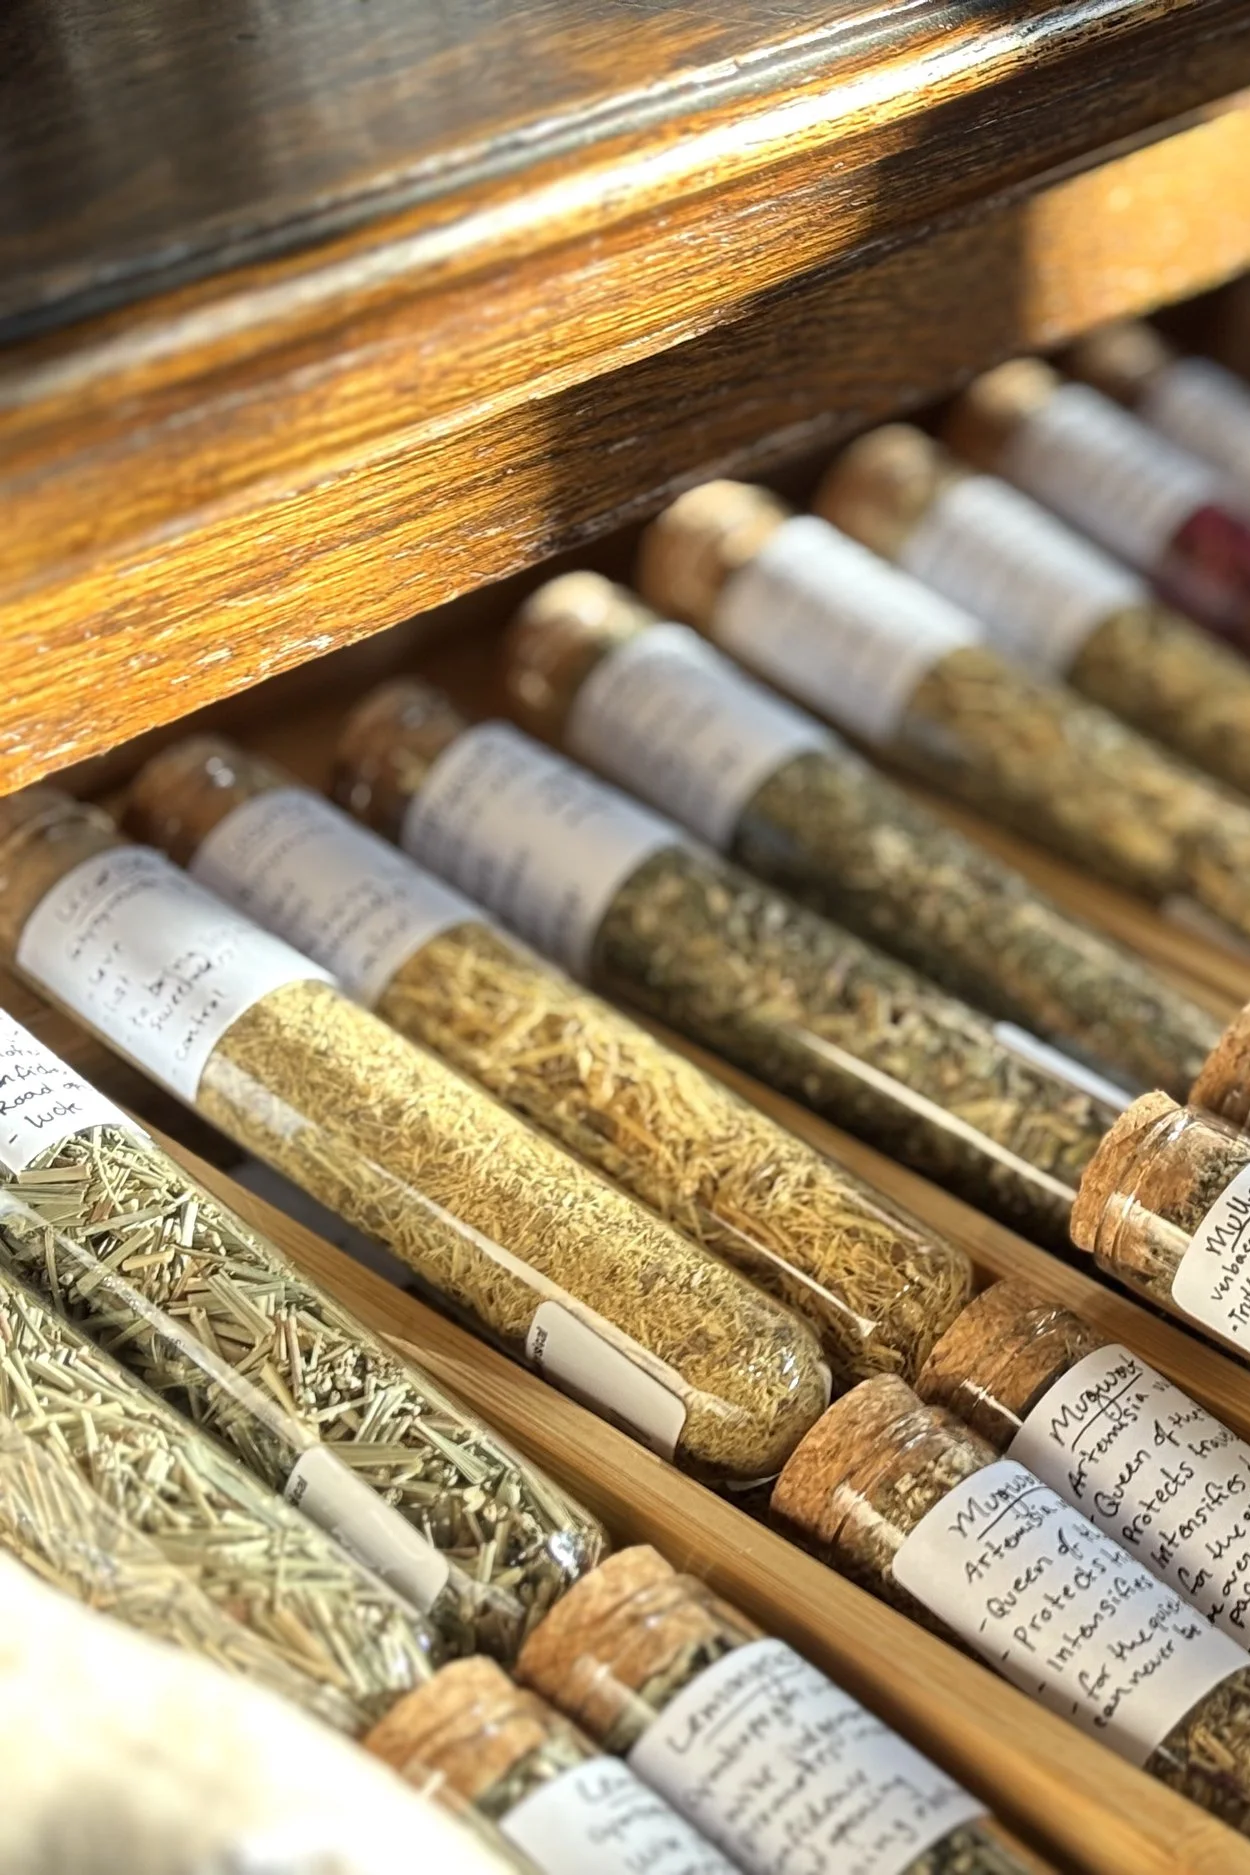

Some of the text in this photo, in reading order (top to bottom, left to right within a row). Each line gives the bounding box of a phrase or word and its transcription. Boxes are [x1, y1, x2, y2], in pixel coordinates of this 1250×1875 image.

[1068, 1391, 1149, 1499] Artemisia
[1093, 1449, 1152, 1518] Queen
[1153, 1419, 1180, 1447] of
[1150, 1473, 1246, 1569] Intensifies
[1205, 1522, 1246, 1561] the
[986, 1554, 1054, 1621] Queen
[1078, 1662, 1113, 1701] for
[1108, 1626, 1152, 1664] the
